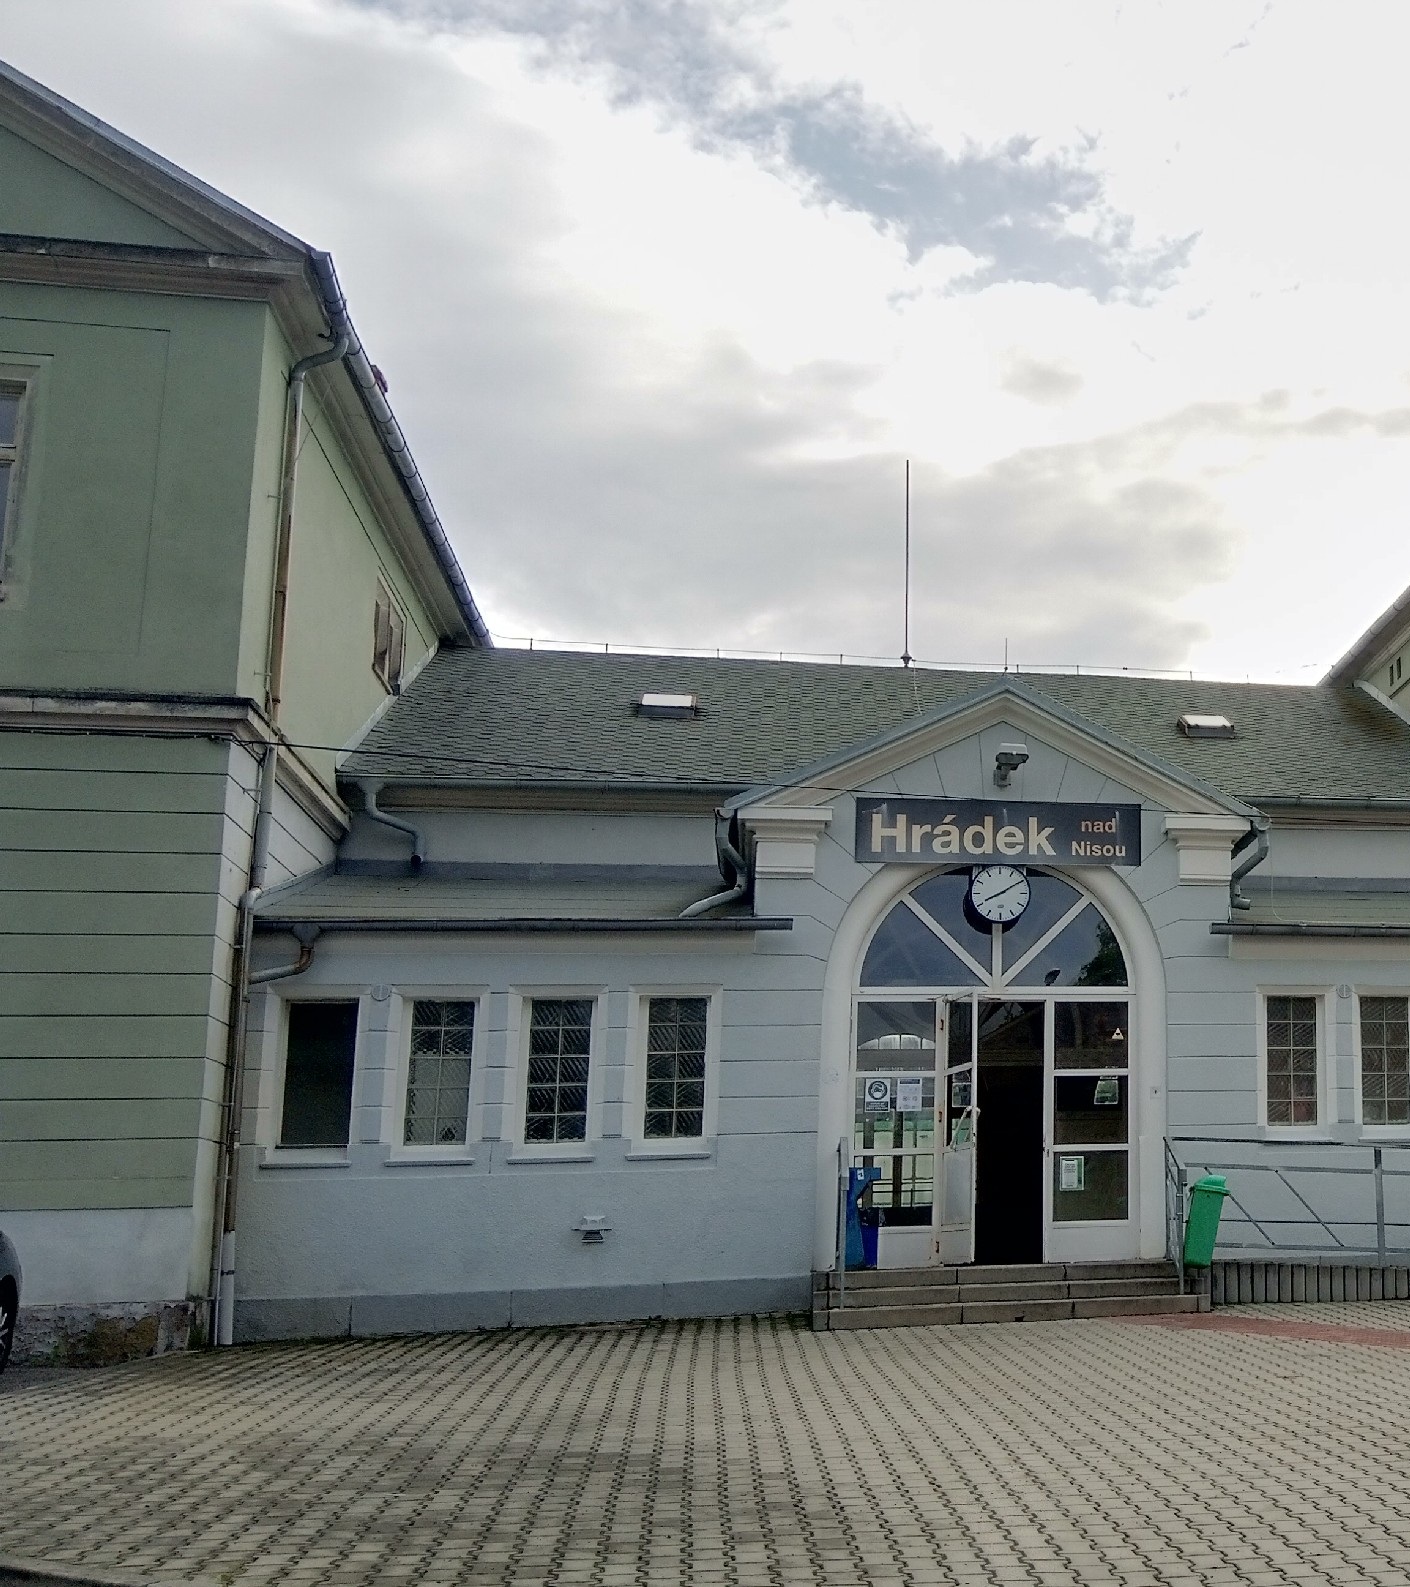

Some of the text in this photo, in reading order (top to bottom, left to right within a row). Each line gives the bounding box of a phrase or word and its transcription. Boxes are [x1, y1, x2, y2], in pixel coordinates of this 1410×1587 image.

[1081, 817, 1117, 833] nad
[871, 813, 1057, 856] Hrádek
[1071, 840, 1126, 857] Nisou
